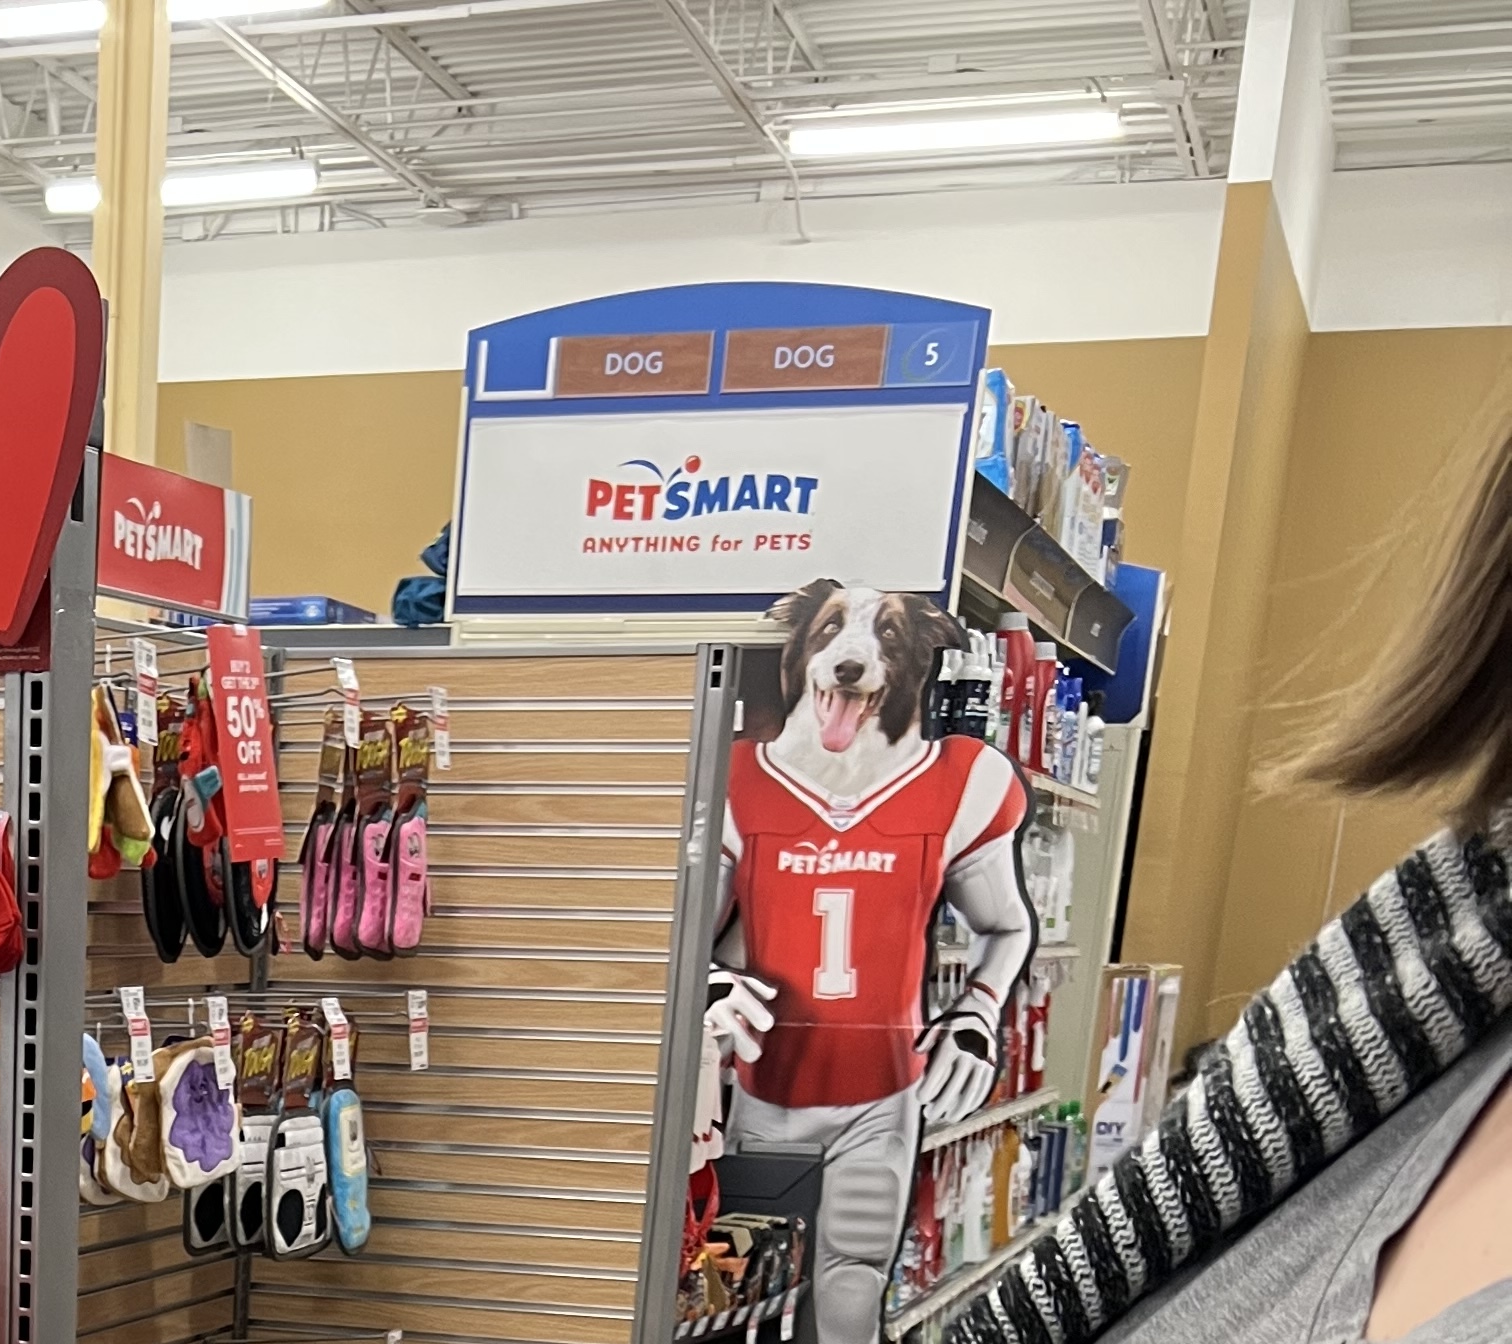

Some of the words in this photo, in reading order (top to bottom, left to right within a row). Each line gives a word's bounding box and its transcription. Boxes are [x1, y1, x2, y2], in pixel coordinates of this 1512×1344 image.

[605, 351, 664, 376] DOG
[774, 345, 835, 370] DOG
[924, 342, 939, 366] 5
[585, 472, 819, 521] PETSMART
[113, 508, 204, 570] PETSMART
[582, 534, 700, 553] ANYTHING
[711, 533, 743, 552] for
[753, 532, 812, 551] PETS
[226, 695, 265, 738] 50%
[237, 740, 261, 764] OFF
[777, 850, 897, 875] PETSMART
[812, 887, 857, 1000] 1
